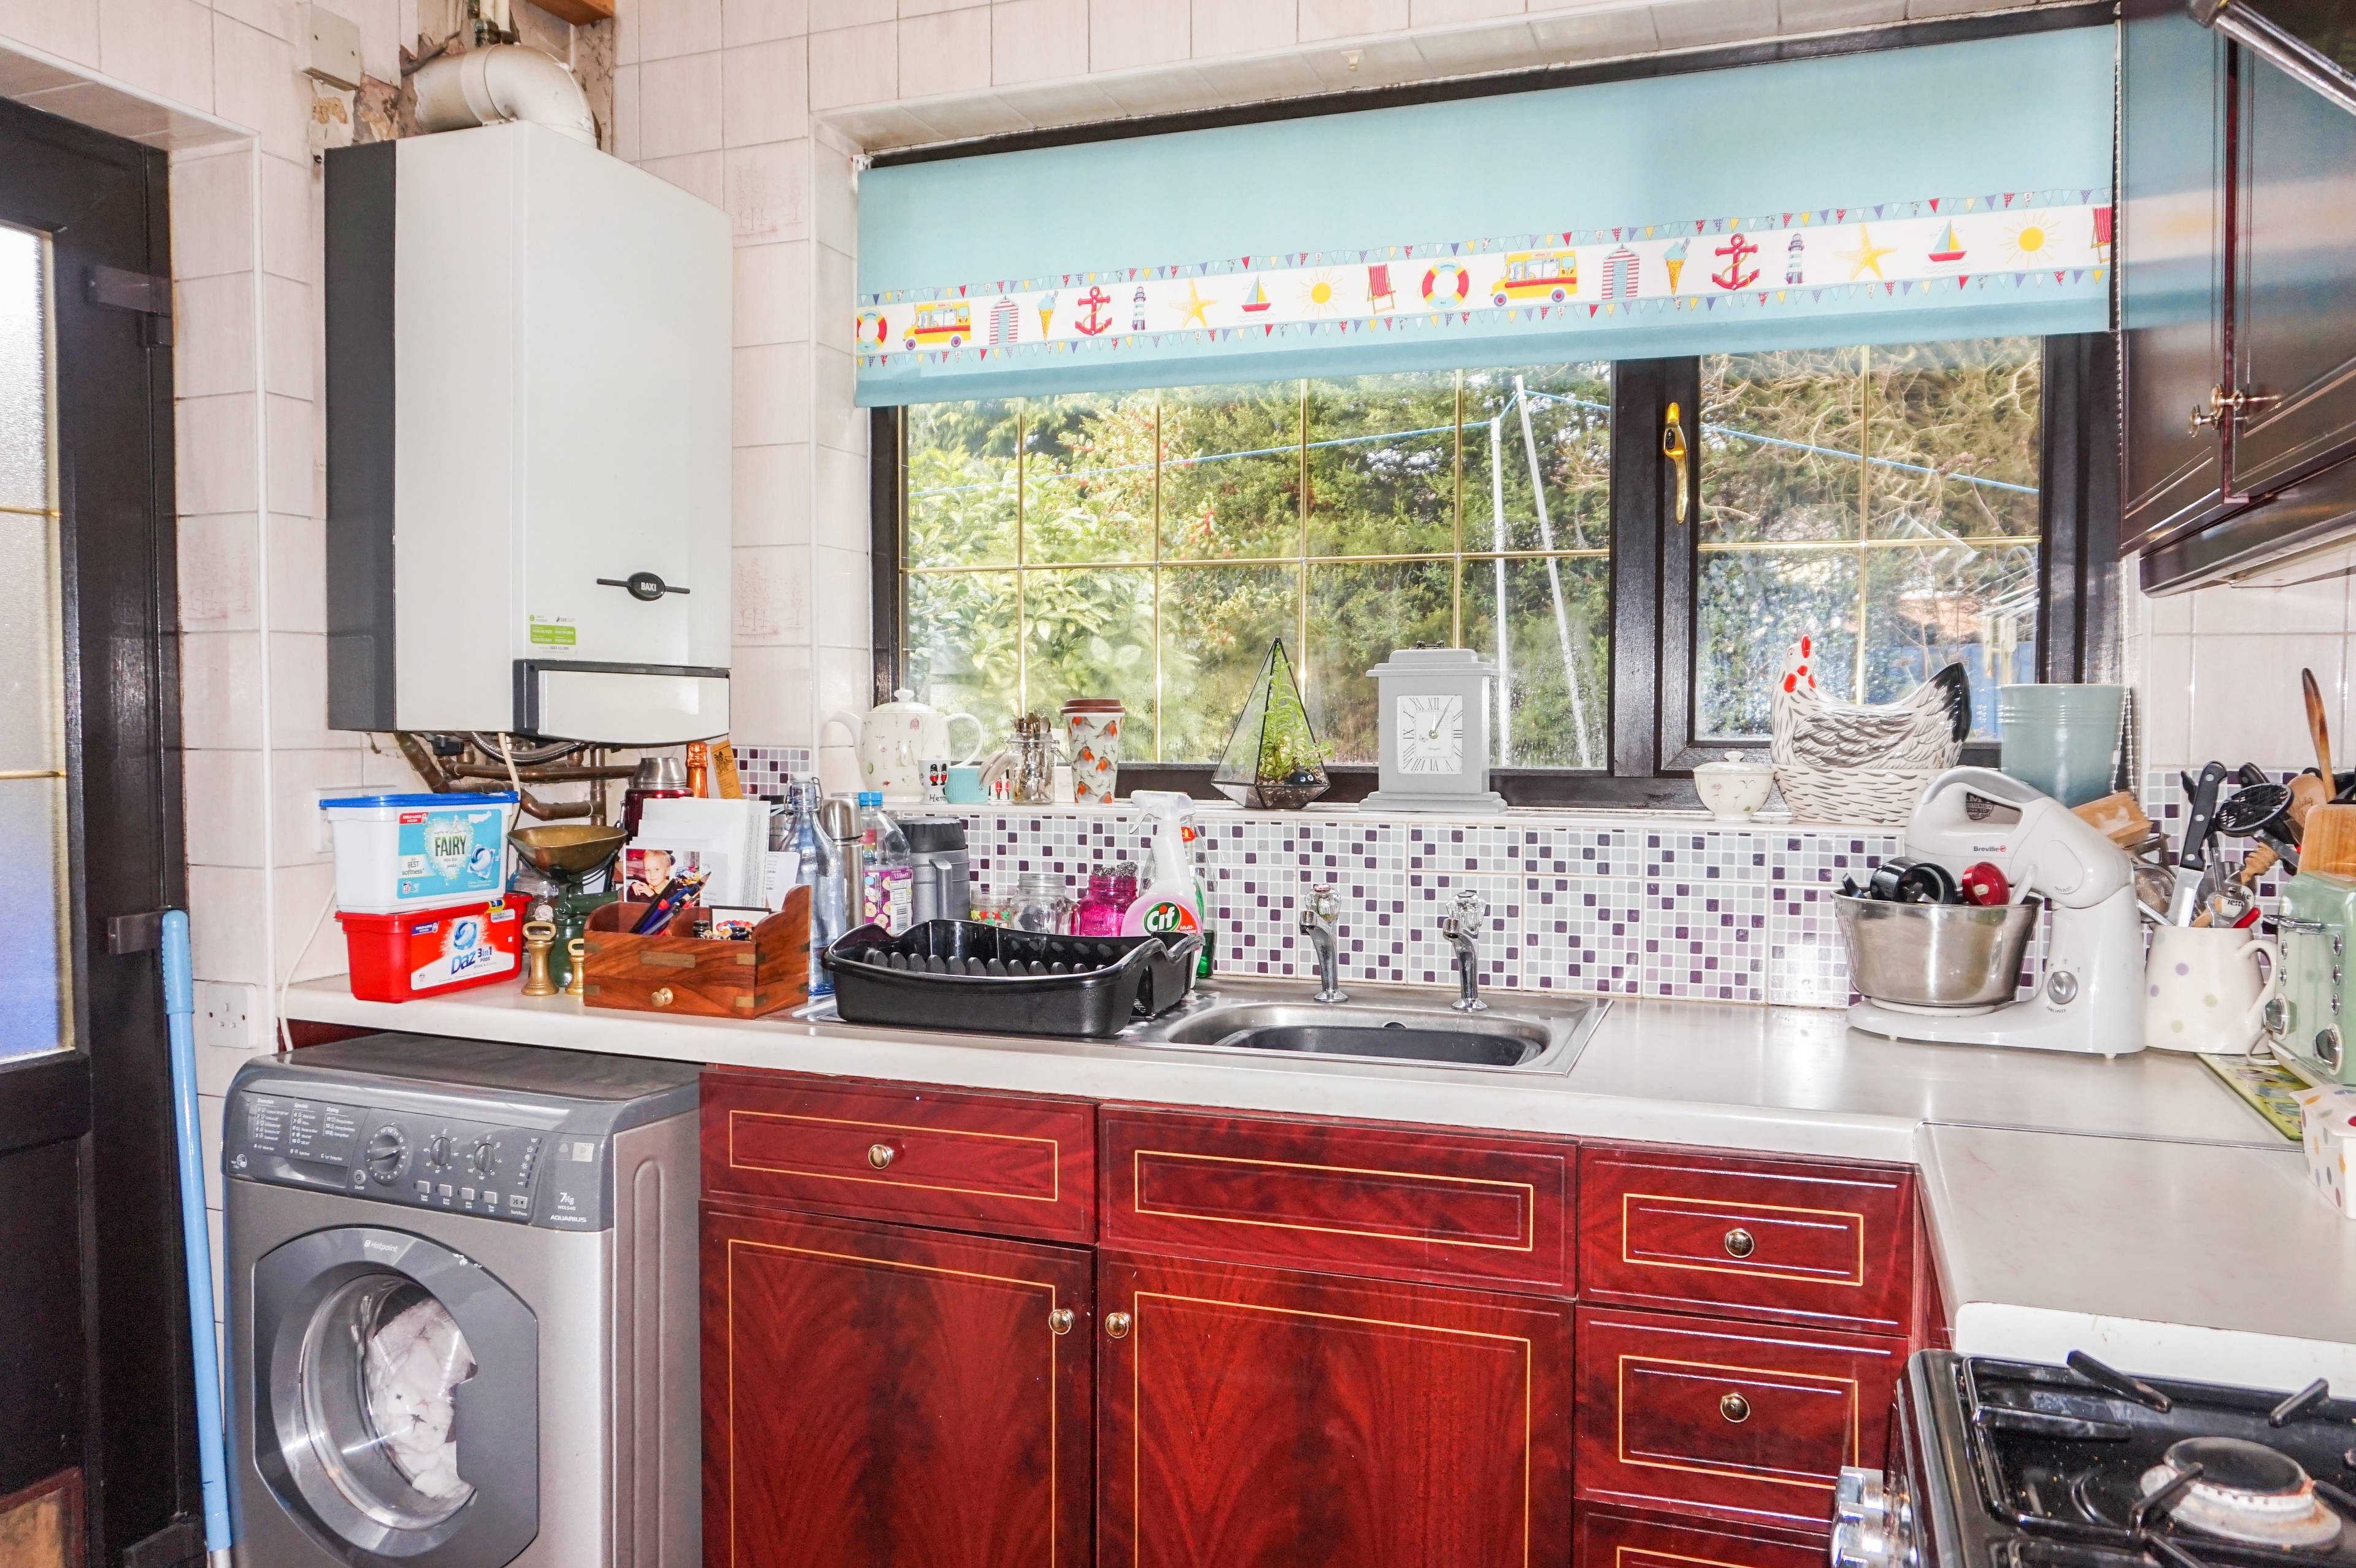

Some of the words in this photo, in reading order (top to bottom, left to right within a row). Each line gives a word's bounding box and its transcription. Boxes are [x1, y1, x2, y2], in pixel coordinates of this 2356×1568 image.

[641, 582, 656, 591] BAXI
[1428, 698, 1439, 710] XII
[435, 835, 466, 857] FAIRY
[1147, 905, 1175, 931] Cif
[451, 951, 476, 975] Daz
[477, 946, 492, 958] 3in1
[371, 1242, 398, 1252] Hotpoint
